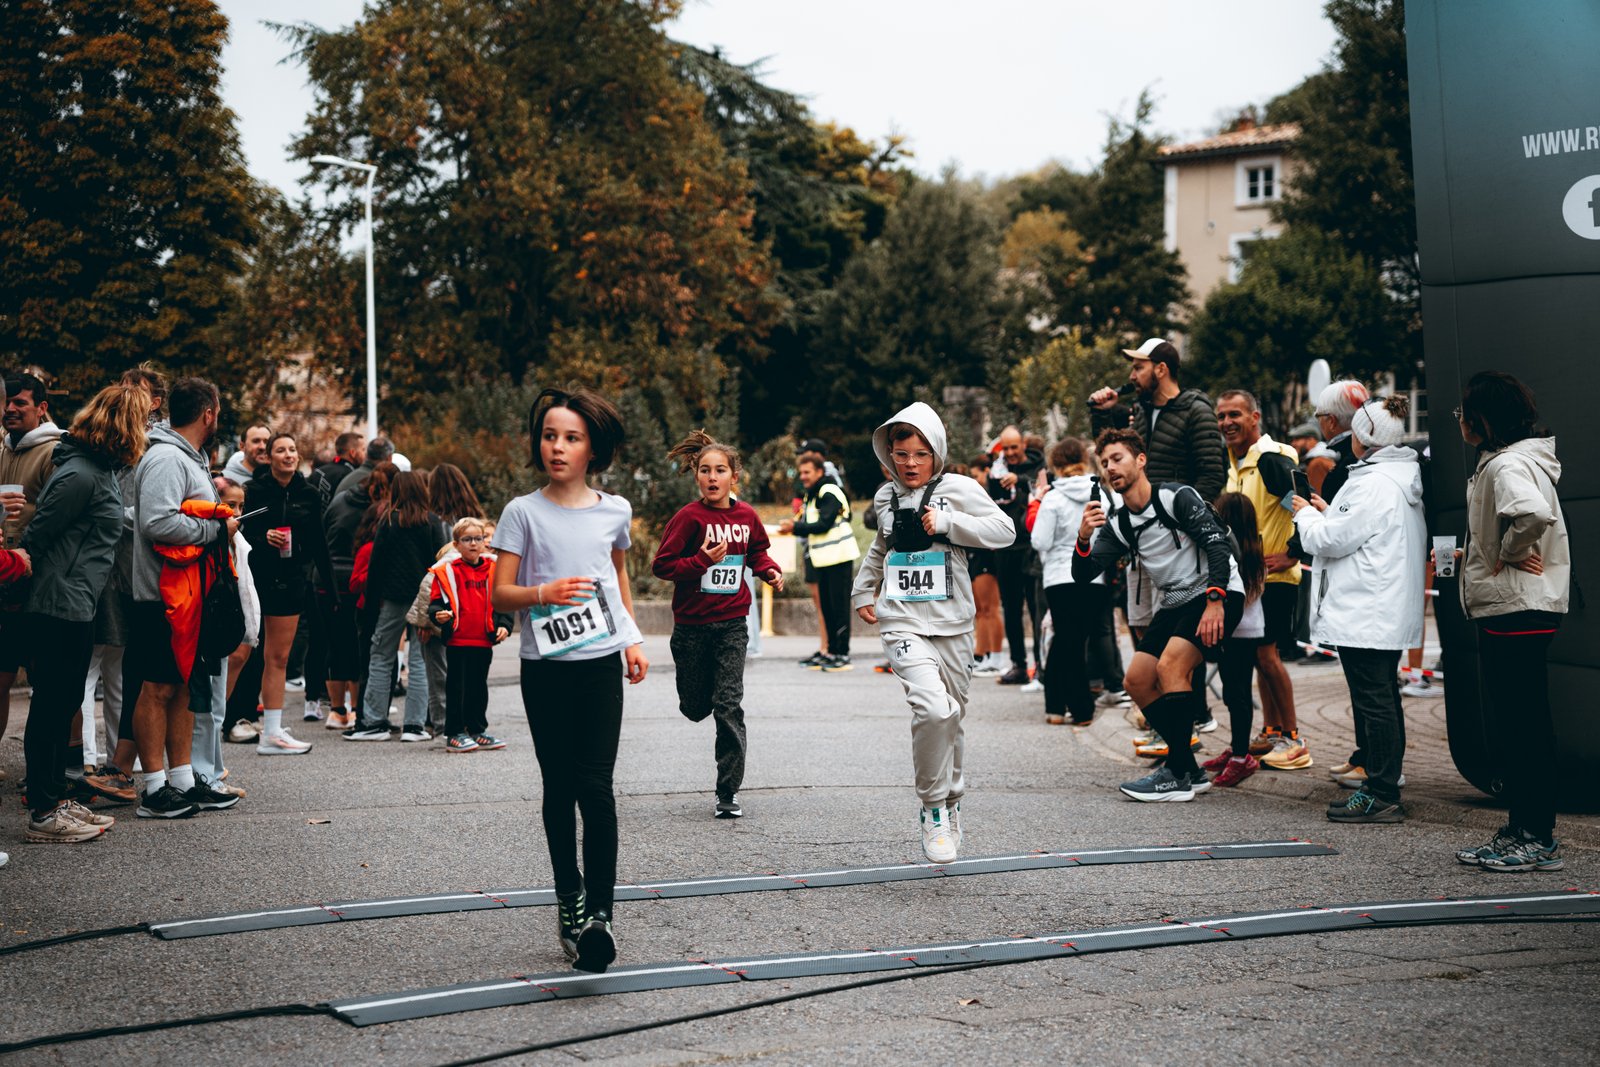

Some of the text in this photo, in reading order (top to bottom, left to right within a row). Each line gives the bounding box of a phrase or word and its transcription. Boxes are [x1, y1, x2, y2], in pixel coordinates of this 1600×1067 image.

[1522, 126, 1600, 158] WWW.R
[705, 523, 750, 544] AMOR
[711, 568, 737, 585] 673
[898, 570, 934, 591] 544
[541, 607, 596, 645] 1091
[1155, 781, 1178, 792] HOKA
